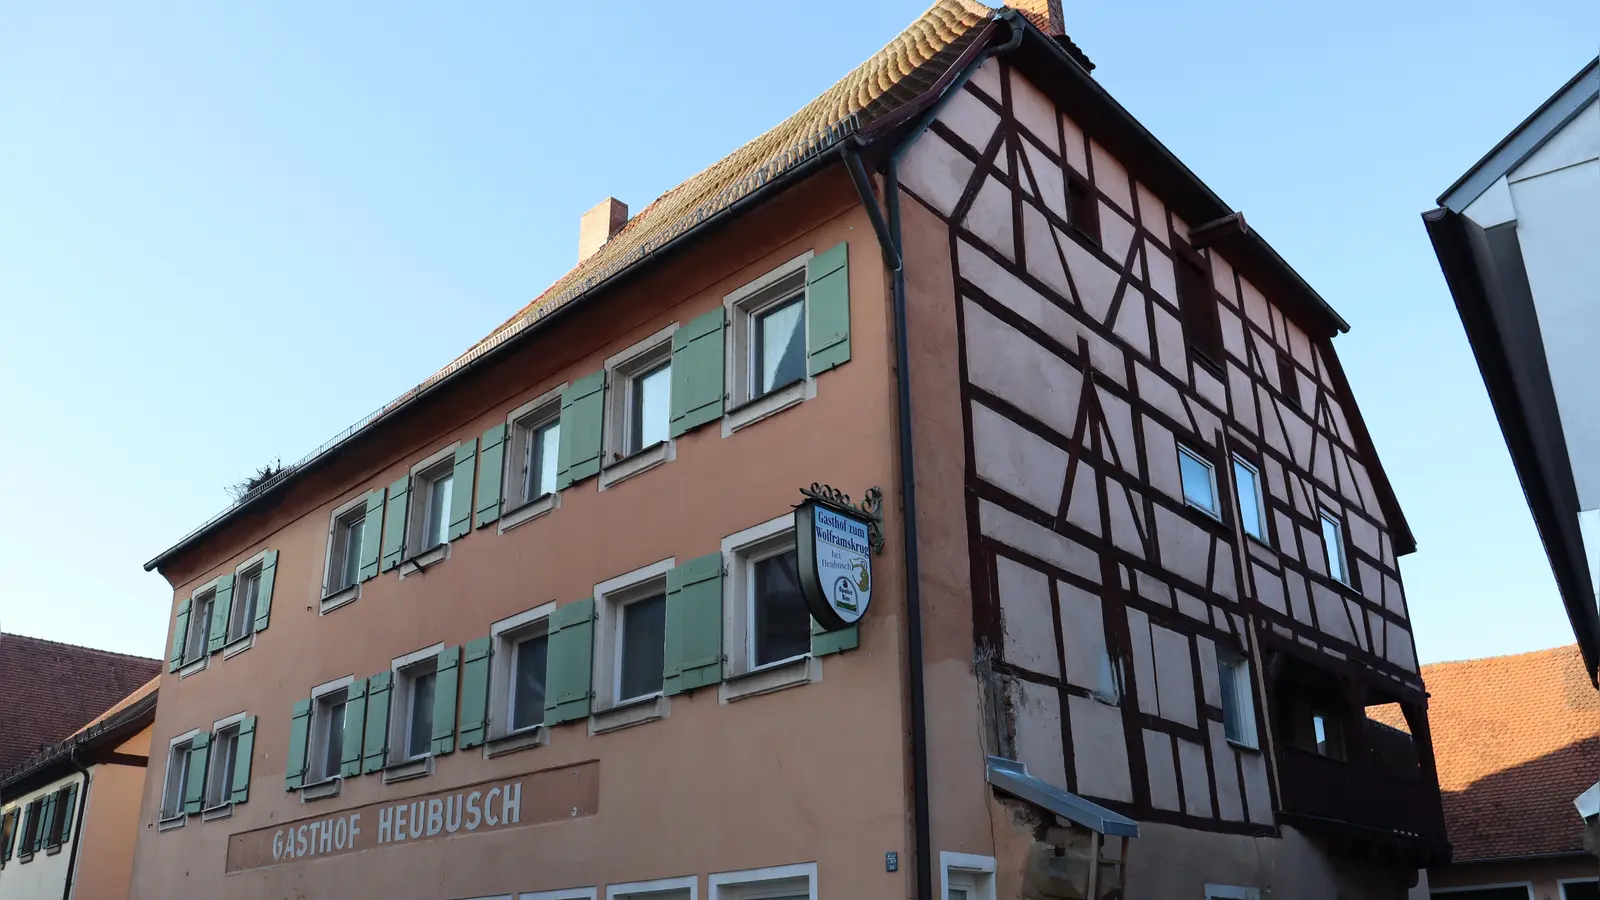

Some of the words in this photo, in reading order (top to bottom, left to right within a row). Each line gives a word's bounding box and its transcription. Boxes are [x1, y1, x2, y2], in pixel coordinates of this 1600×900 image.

[818, 511, 847, 531] Gasthof
[849, 525, 864, 538] zum
[816, 526, 869, 558] Wolframskrug
[832, 550, 841, 559] bei
[822, 559, 851, 570] Heubusch
[272, 813, 361, 860] GASTHOF
[378, 782, 522, 844] HEUBUSCH
